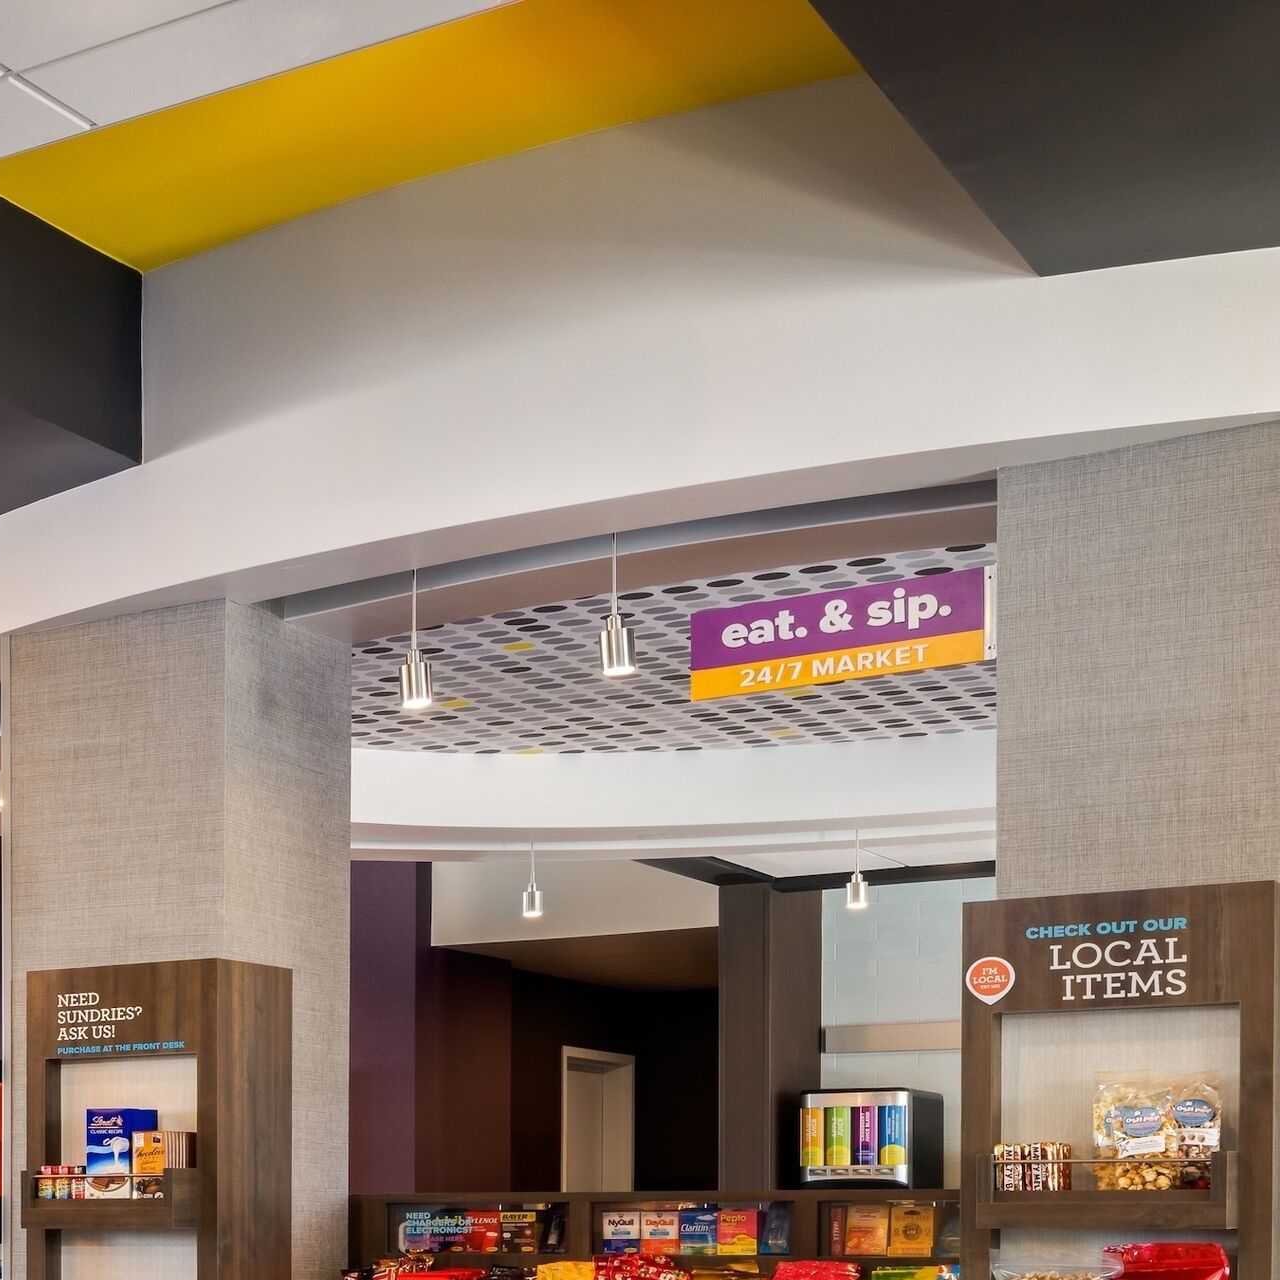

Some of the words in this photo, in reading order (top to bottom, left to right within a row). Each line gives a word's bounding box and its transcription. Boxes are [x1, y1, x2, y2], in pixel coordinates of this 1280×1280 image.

[721, 610, 808, 648] eat.
[819, 599, 854, 633] &
[867, 587, 952, 630] sip.
[740, 661, 803, 687] 24/7
[812, 643, 929, 678] MARKET
[1025, 923, 1092, 940] CHECK
[1096, 920, 1138, 935] OUT
[1142, 917, 1188, 932] OUR
[1049, 937, 1188, 970] LOCAL
[972, 974, 1008, 985] LOCAL
[1062, 968, 1188, 1001] ITEMS
[57, 992, 100, 1007] NEED
[57, 1006, 143, 1024] SUNDRIES?
[57, 1026, 88, 1041] ASK
[92, 1024, 116, 1039] US!
[57, 1045, 100, 1055] PURCHASE
[102, 1045, 113, 1053] AT
[114, 1044, 131, 1052] THE
[132, 1042, 161, 1051] FRONT
[162, 1041, 185, 1049] DESK
[406, 1219, 456, 1227] CHARGERS
[608, 1218, 634, 1226] NyQuil
[646, 1218, 674, 1226] DayQuil
[720, 1214, 747, 1223] Pepto
[406, 1226, 472, 1234] ELECTRONICS?
[681, 1223, 709, 1232] Claritin
